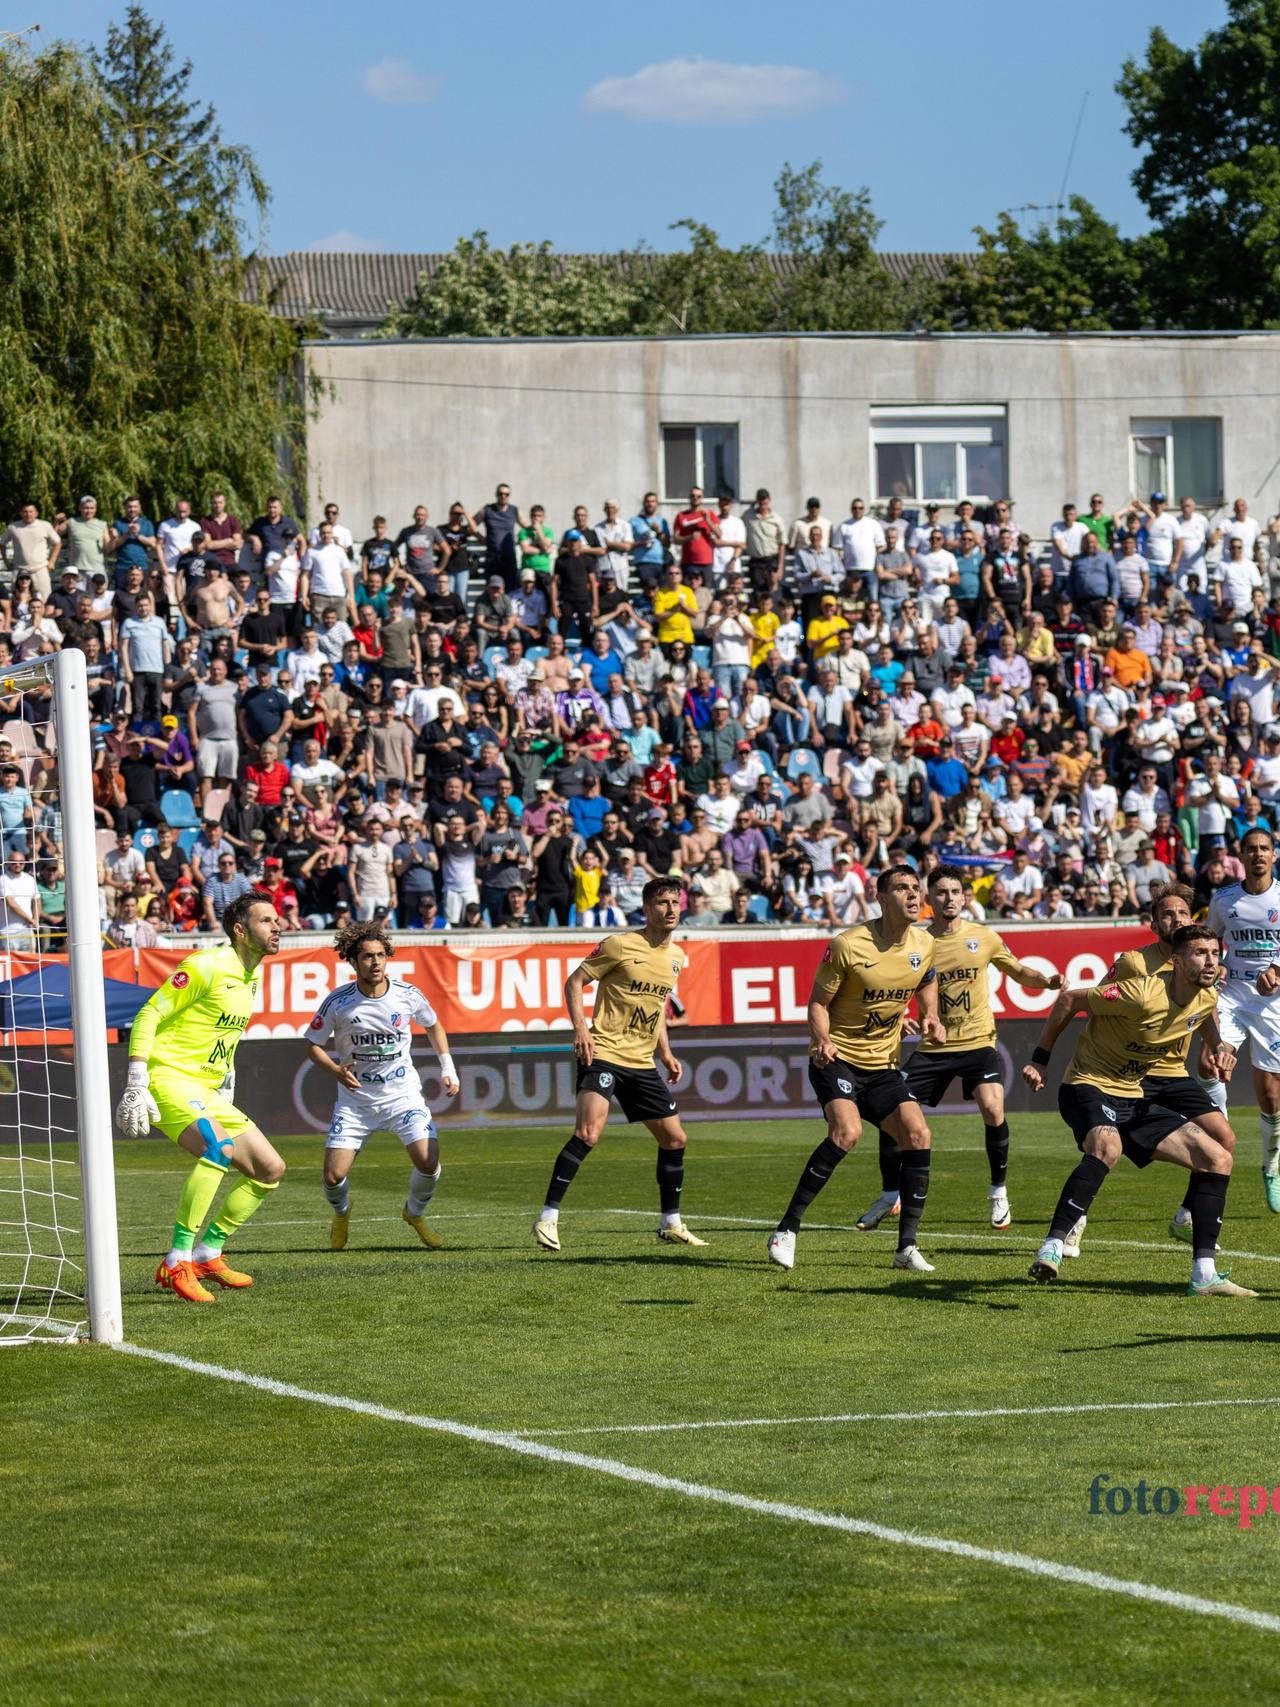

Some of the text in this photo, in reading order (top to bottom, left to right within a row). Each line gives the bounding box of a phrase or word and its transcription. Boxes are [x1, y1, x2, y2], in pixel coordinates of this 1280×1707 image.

[938, 967, 979, 982] AXBET
[863, 988, 916, 1001] MAXBET
[351, 1032, 401, 1046] UNIBET
